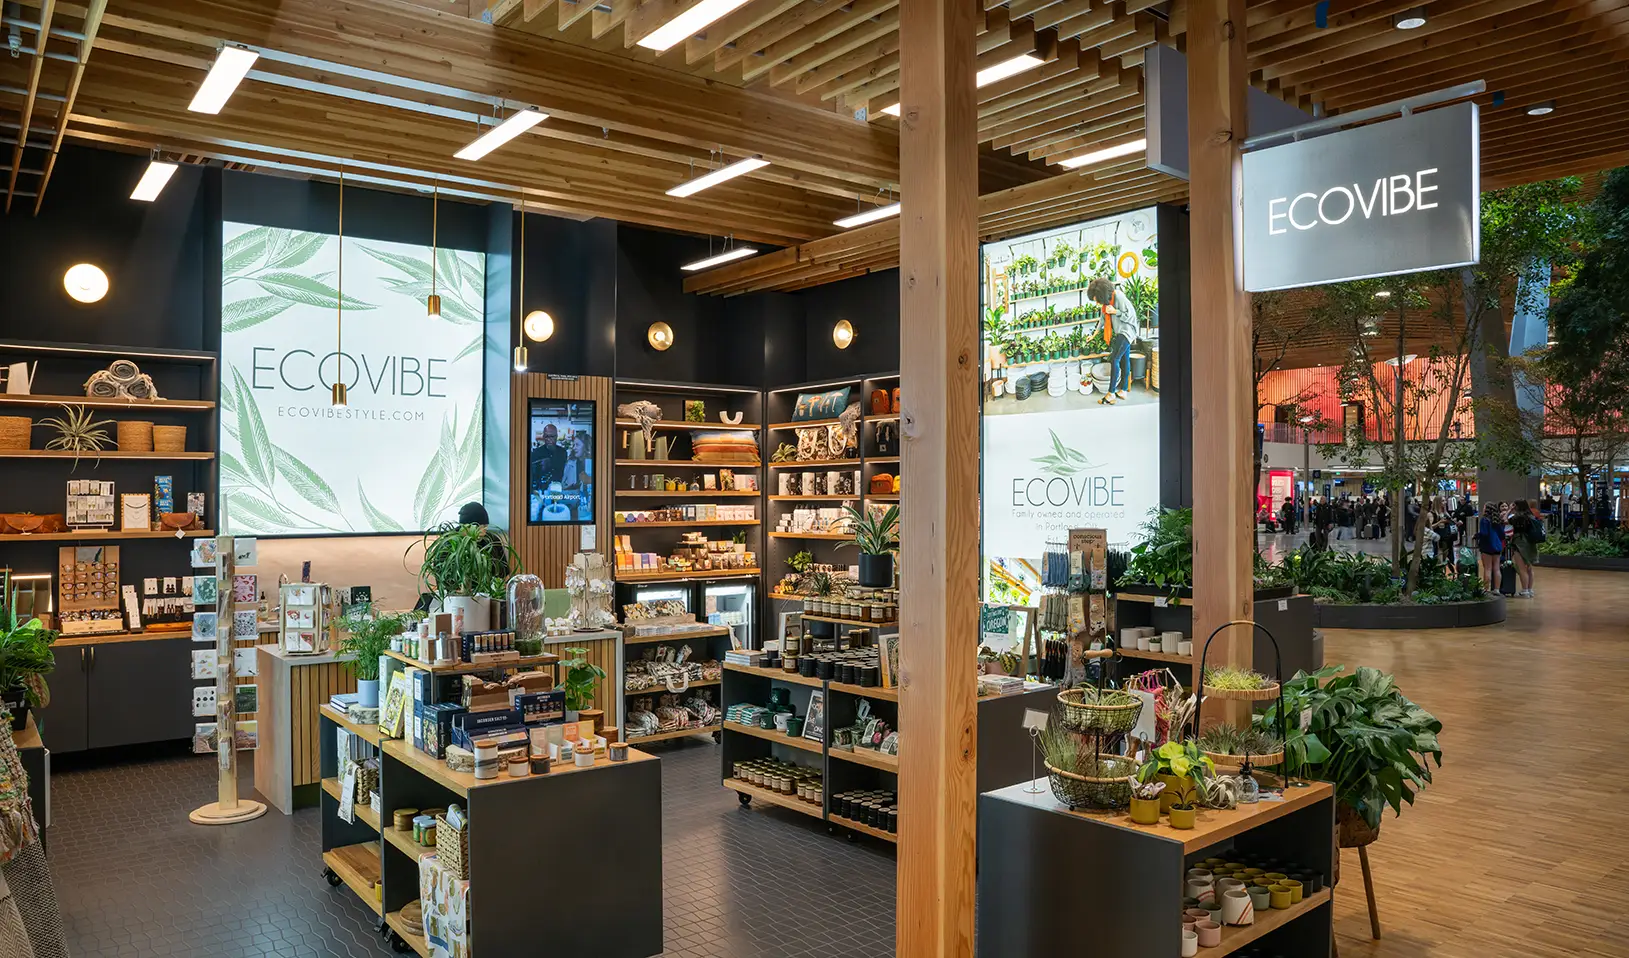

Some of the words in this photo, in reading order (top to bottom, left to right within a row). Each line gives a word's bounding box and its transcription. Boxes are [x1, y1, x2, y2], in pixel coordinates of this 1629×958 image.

[1269, 168, 1439, 236] ECOVIBE
[252, 347, 447, 398] ECOVIBE
[278, 406, 425, 421] ECOVIBESTYLE.COM
[1012, 475, 1125, 507] ECOVIBE
[1012, 508, 1034, 519] Family
[1036, 510, 1063, 519] owned
[1065, 510, 1082, 519] and
[1084, 509, 1125, 521] operated
[1036, 522, 1044, 531] in
